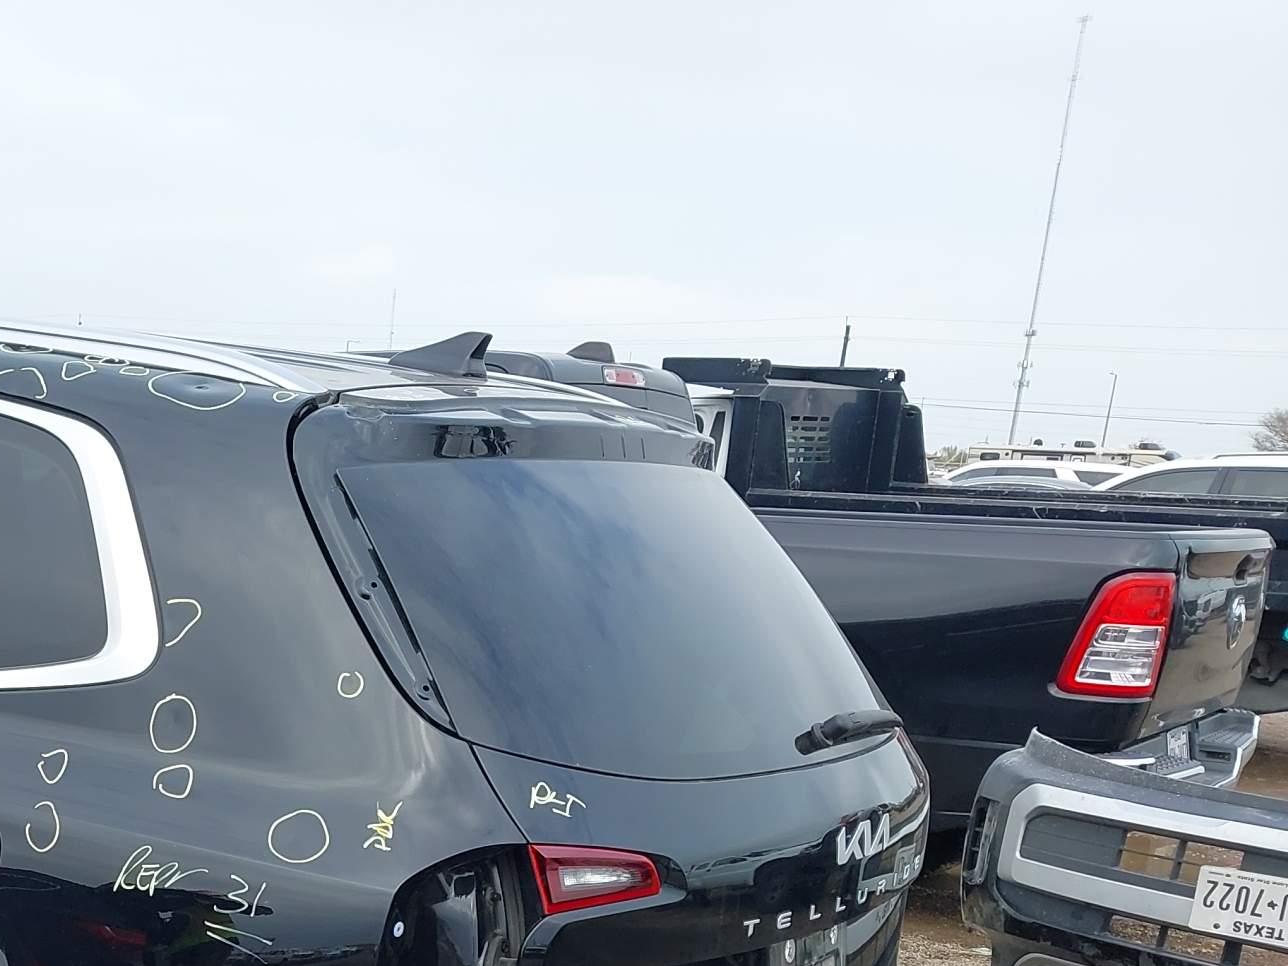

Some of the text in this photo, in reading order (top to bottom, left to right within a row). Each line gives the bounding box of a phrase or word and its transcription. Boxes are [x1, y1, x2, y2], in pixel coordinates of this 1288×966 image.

[836, 813, 890, 866] KIA
[743, 854, 921, 937] TELLURIDE
[1232, 920, 1285, 941] TEXAS
